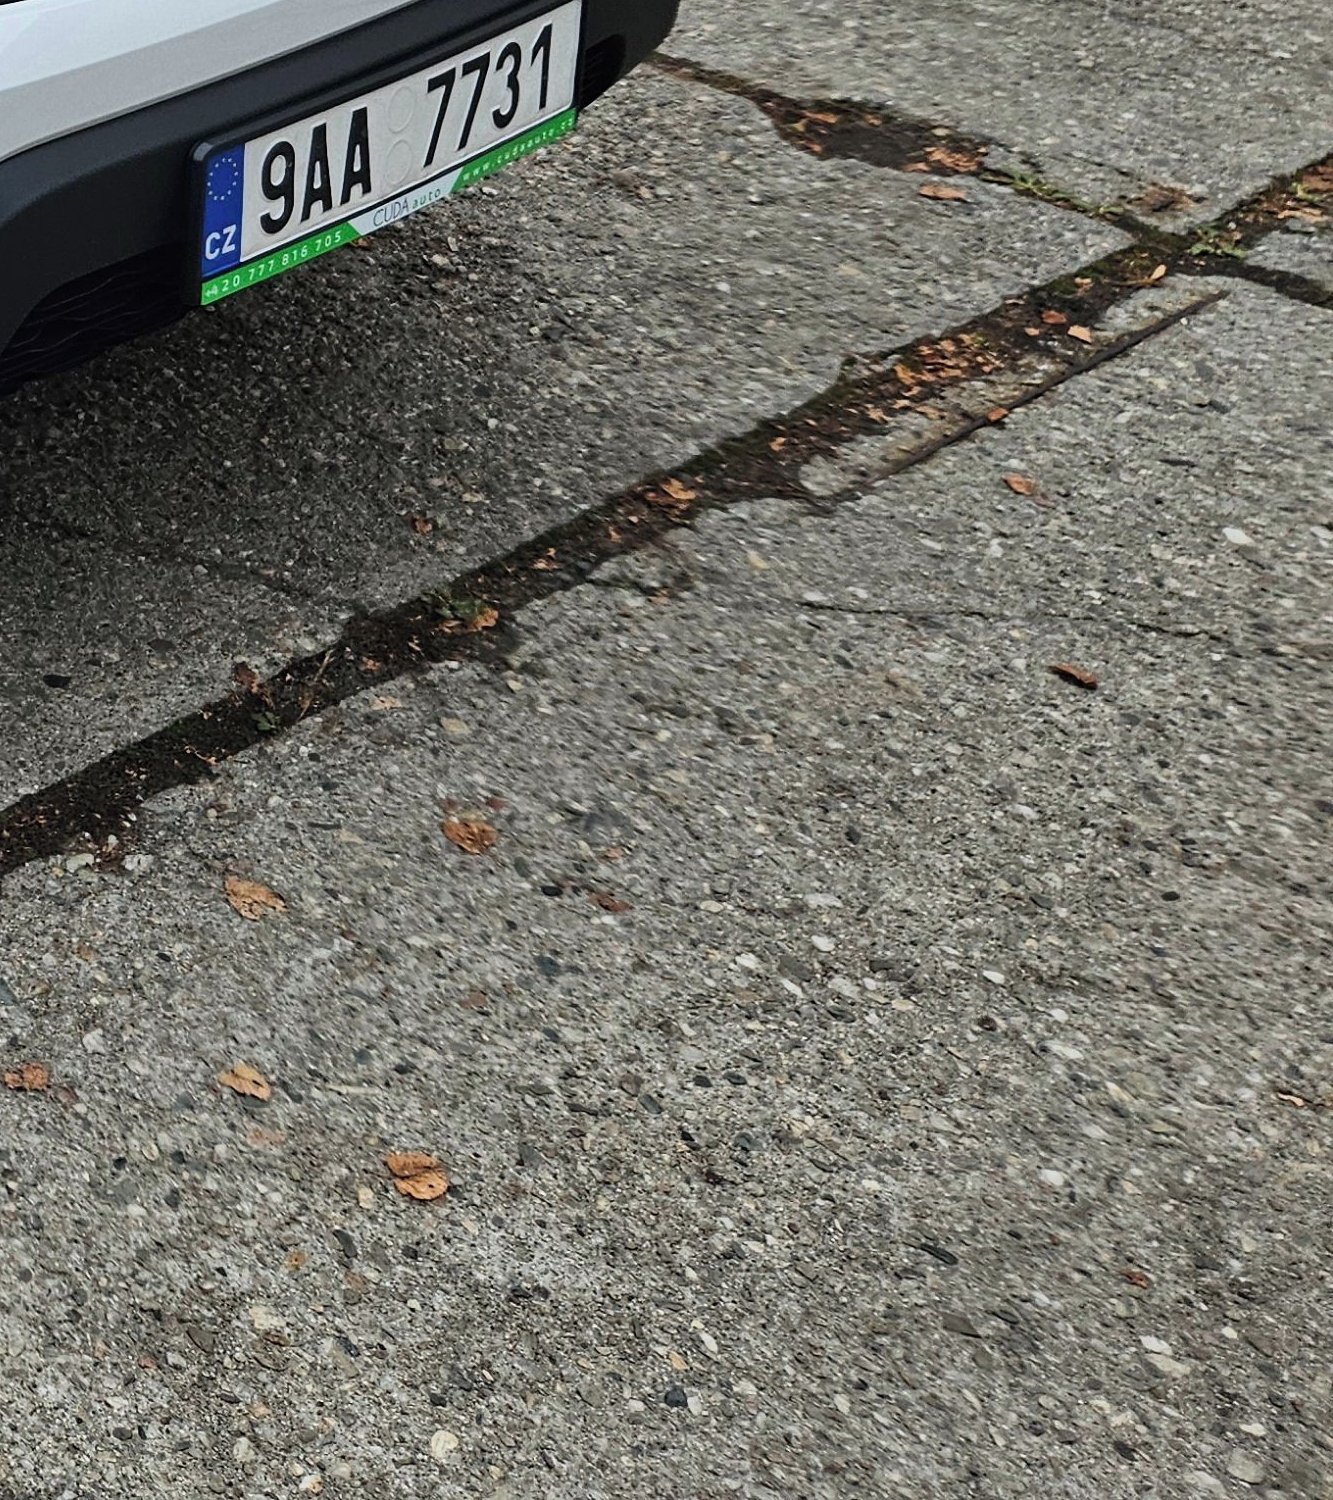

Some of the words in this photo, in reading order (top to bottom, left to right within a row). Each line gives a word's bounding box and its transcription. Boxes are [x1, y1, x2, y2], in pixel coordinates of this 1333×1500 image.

[259, 106, 372, 235] 9AA
[423, 23, 553, 168] 7731
[205, 224, 237, 260] CZ
[205, 275, 240, 298] +420
[249, 260, 276, 281] 777
[282, 245, 309, 266] 816
[315, 230, 342, 252] 705
